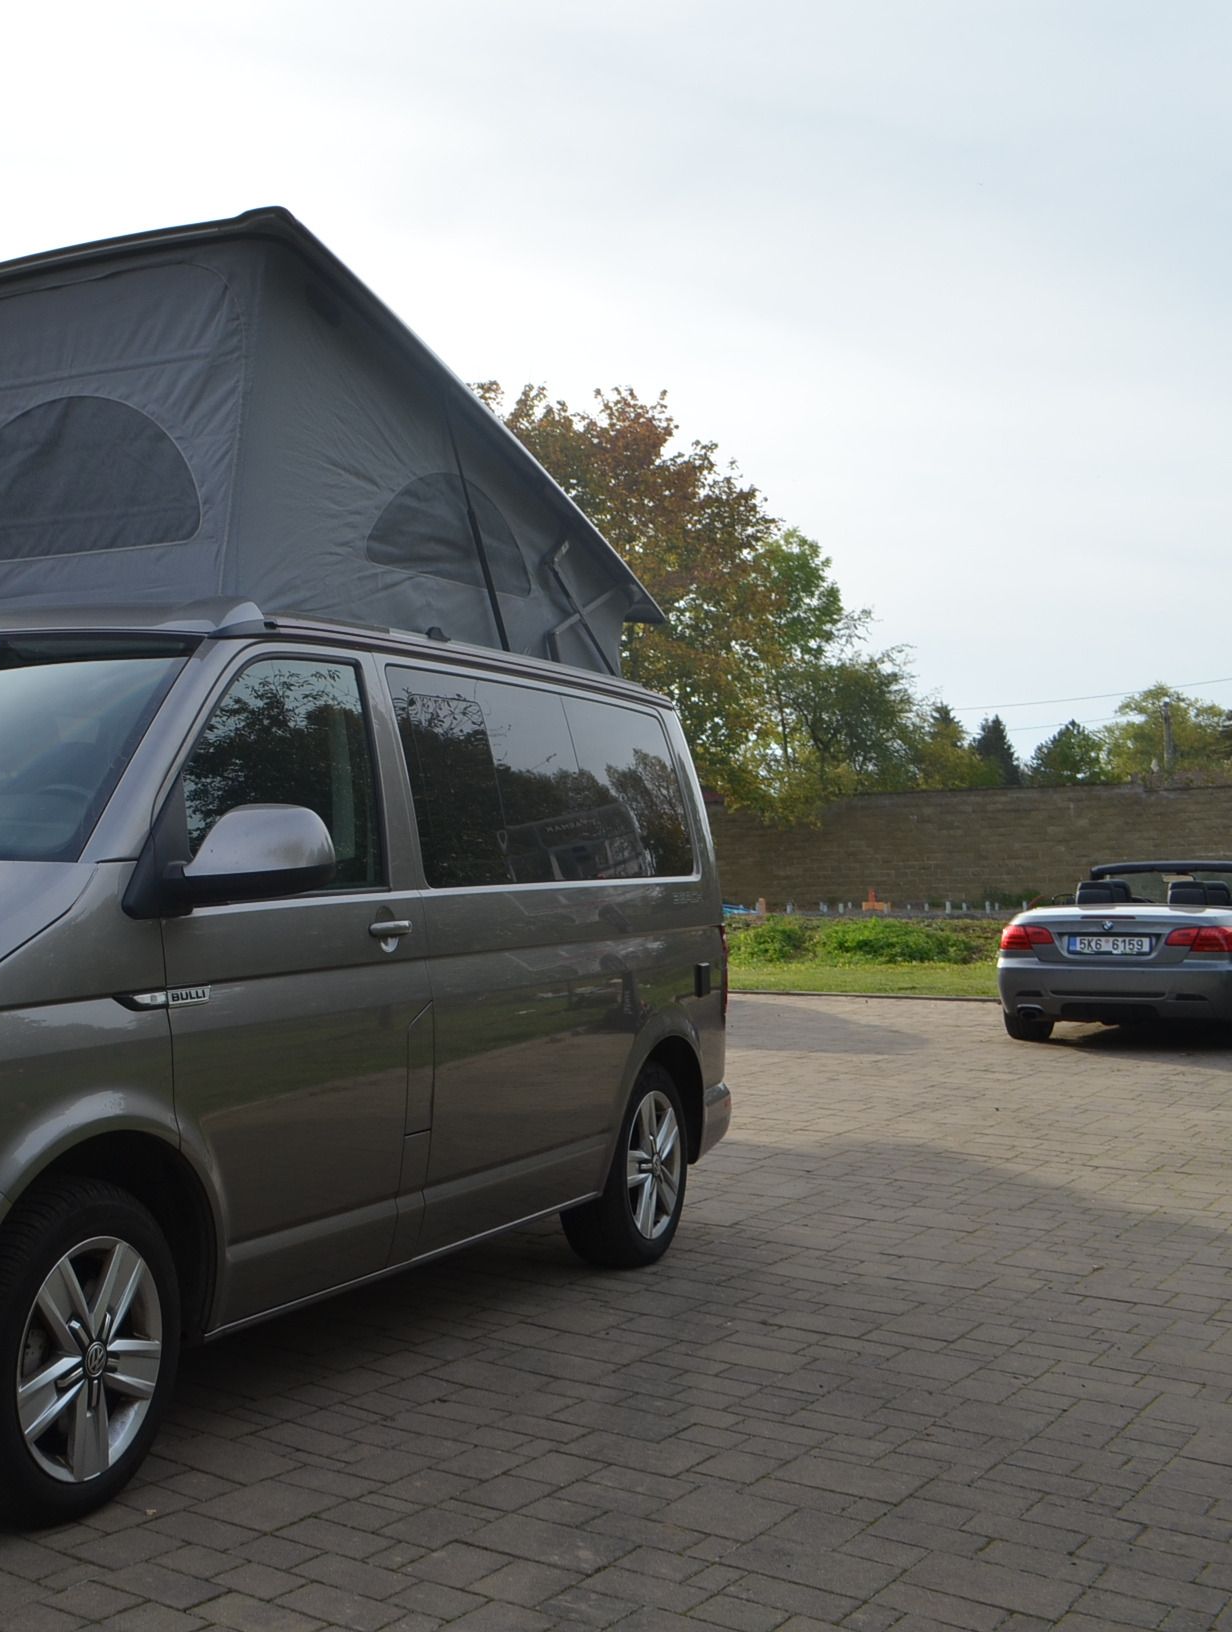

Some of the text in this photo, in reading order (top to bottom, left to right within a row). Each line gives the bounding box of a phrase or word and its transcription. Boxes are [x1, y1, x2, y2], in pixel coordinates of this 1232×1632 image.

[1079, 938, 1144, 951] 5K6 6159
[171, 989, 206, 1002] BULLI
